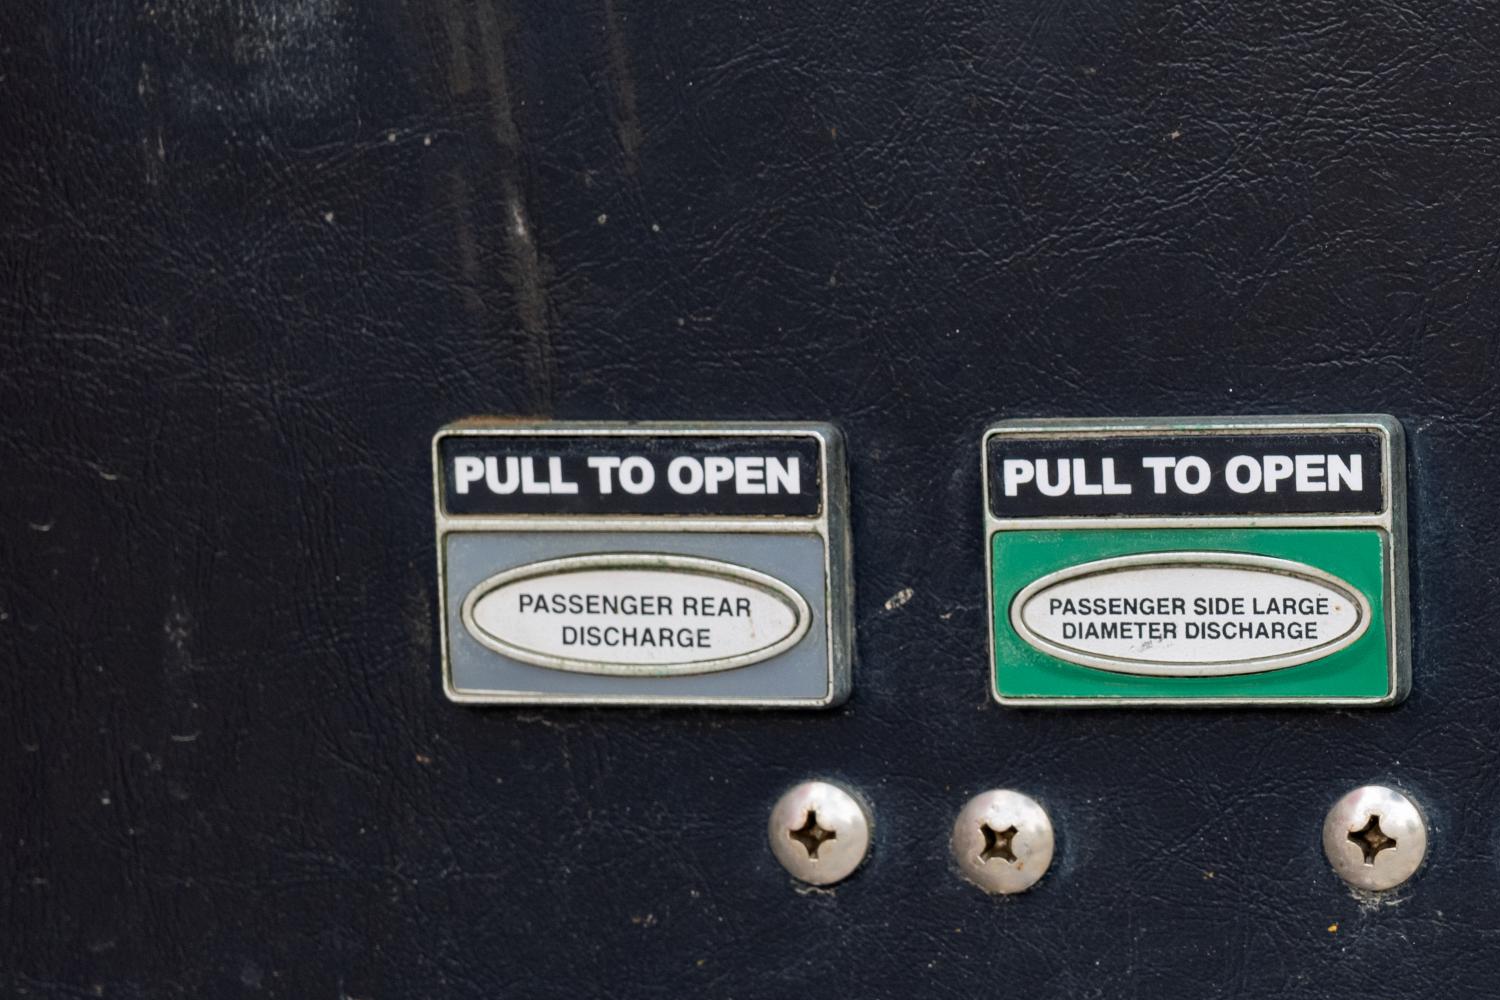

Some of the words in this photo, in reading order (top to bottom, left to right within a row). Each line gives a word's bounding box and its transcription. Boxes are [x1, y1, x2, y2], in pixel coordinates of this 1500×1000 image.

[455, 457, 578, 495] PULL
[588, 456, 655, 494] TO
[668, 456, 800, 494] OPEN
[1003, 458, 1131, 496] PULL
[1143, 456, 1211, 494] TO
[1225, 454, 1363, 494] OPEN
[519, 594, 672, 616] PASSENGER
[683, 597, 751, 617] REAR
[1049, 598, 1186, 616] PASSENGER
[1194, 597, 1245, 616] SIDE
[1253, 597, 1329, 616] LARGE
[562, 627, 711, 648] DISCHARGE
[1063, 622, 1177, 639] DIAMETER
[1186, 621, 1318, 640] DISCHARGE
